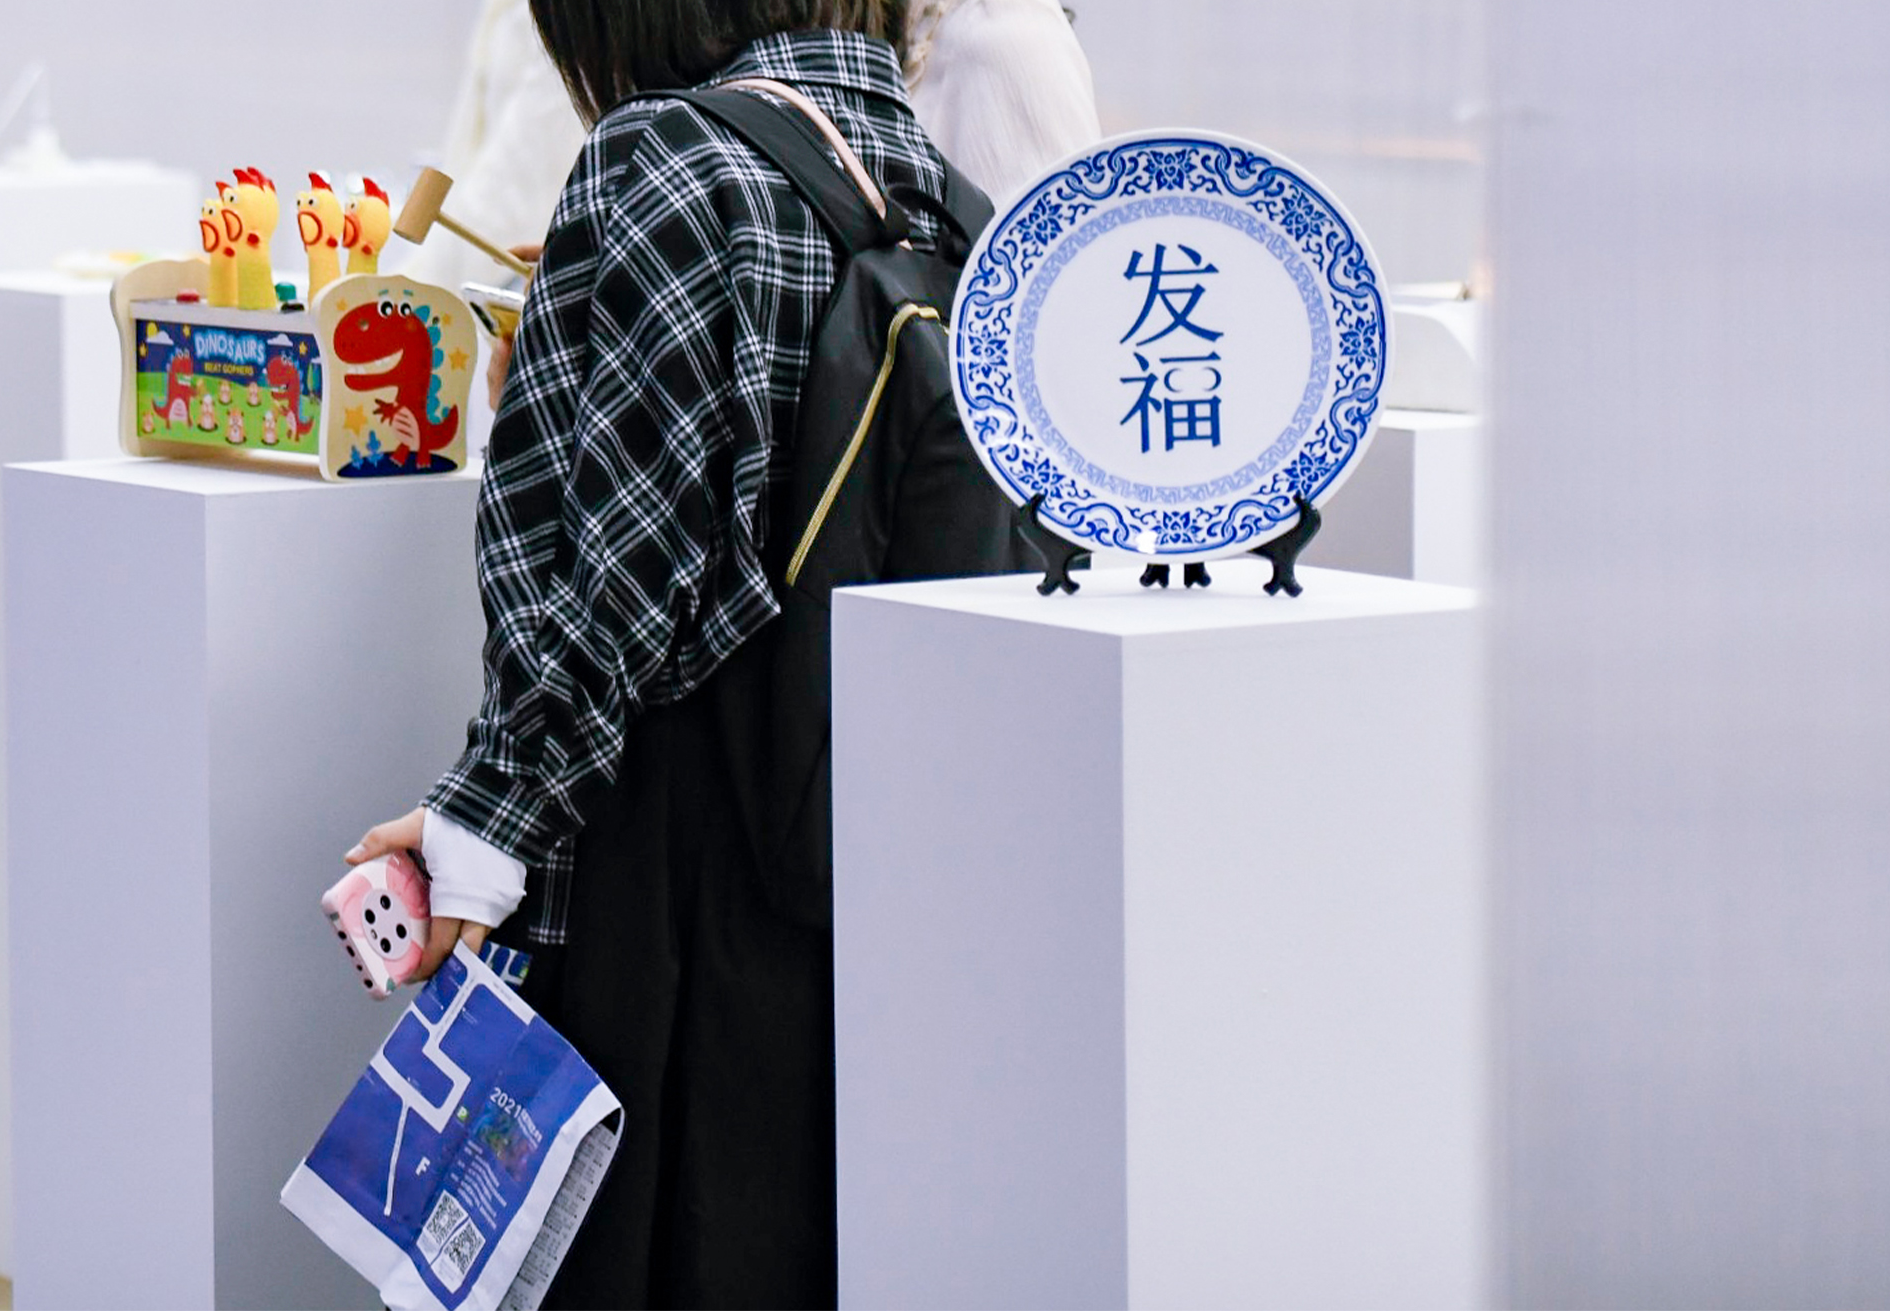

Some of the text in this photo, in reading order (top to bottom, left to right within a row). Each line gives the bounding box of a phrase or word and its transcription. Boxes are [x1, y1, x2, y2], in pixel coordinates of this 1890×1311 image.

[194, 331, 265, 366] DINOSAURS
[1119, 243, 1224, 454] 发福
[490, 1087, 522, 1118] 2021
[415, 1156, 430, 1176] F
